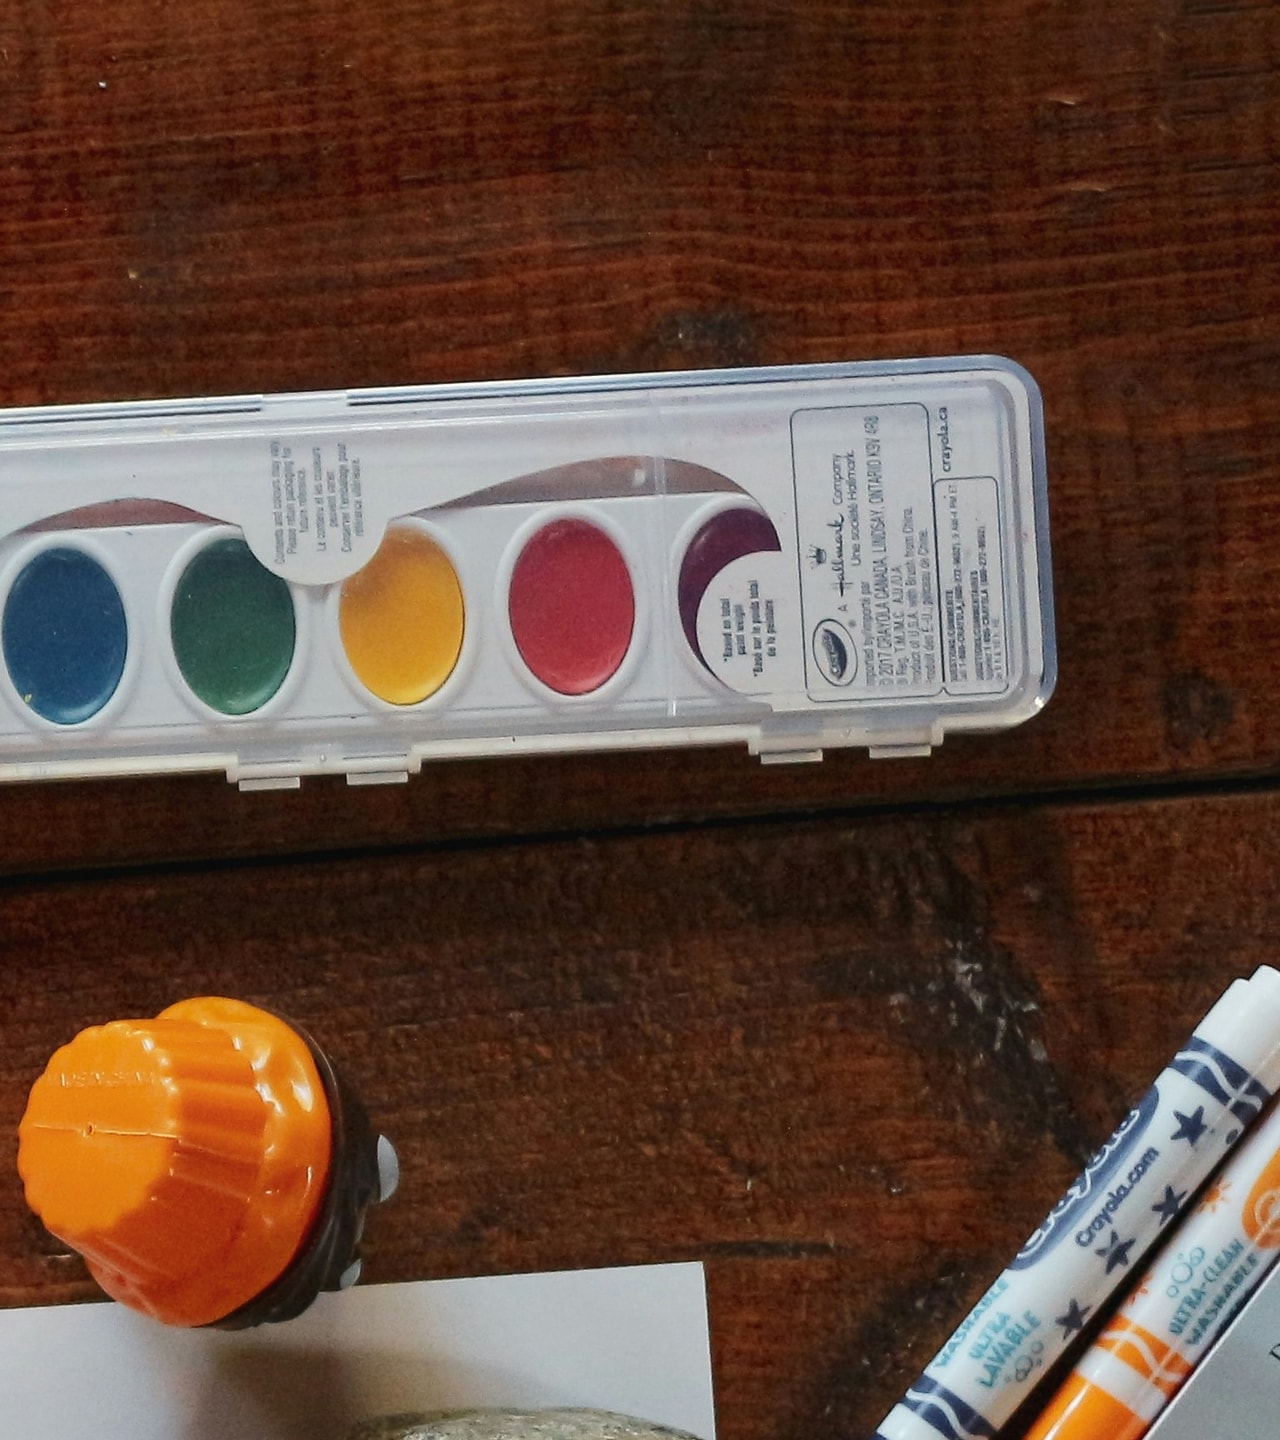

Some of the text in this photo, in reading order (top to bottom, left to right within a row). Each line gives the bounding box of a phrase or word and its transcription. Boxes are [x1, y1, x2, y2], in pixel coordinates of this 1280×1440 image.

[936, 406, 953, 472] crayola.ca
[830, 453, 844, 505] Company
[866, 460, 883, 503] ONTARIO
[825, 512, 854, 597] Hallmark
[850, 542, 861, 566] Une
[874, 601, 892, 648] CRAYOLA
[877, 652, 893, 676] 2017
[1072, 1141, 1160, 1252] Crayola.com
[1163, 1233, 1246, 1338] ULTRA-CLEAN
[1183, 1249, 1261, 1350] WASHABLE
[966, 1308, 1012, 1362] ULTRA
[972, 1306, 1042, 1391] LAVABLE
